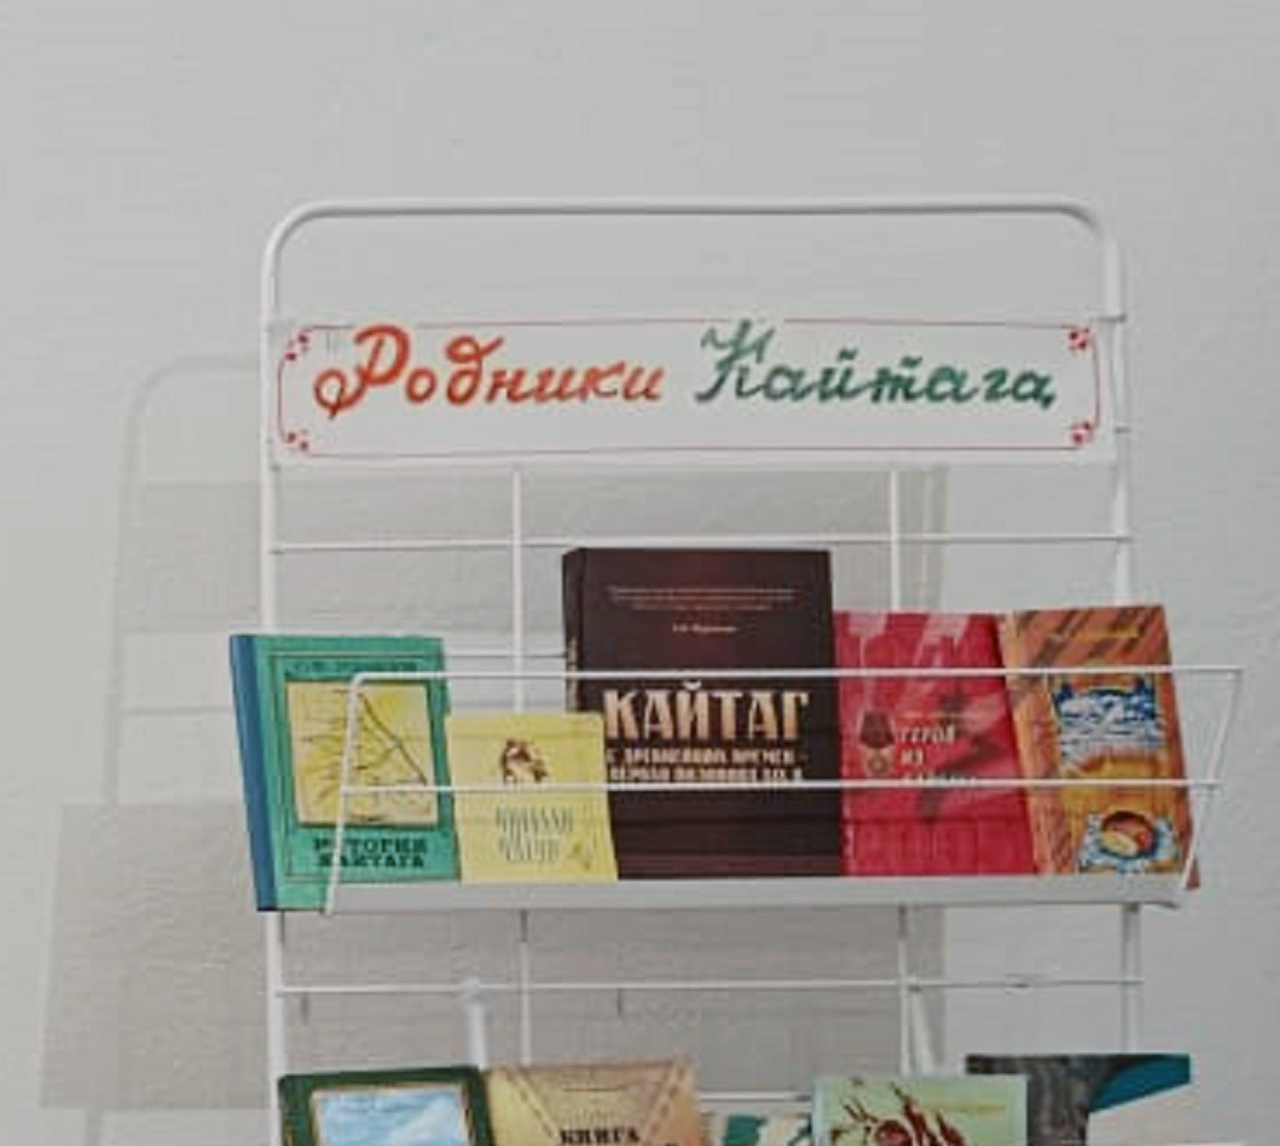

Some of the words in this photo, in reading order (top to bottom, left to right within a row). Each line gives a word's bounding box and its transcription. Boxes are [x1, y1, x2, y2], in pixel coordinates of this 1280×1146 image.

[313, 324, 666, 420] Родники
[694, 318, 1056, 409] Кайтага
[602, 680, 810, 741] КАЙТАГ
[559, 1125, 641, 1146] КНИГА
